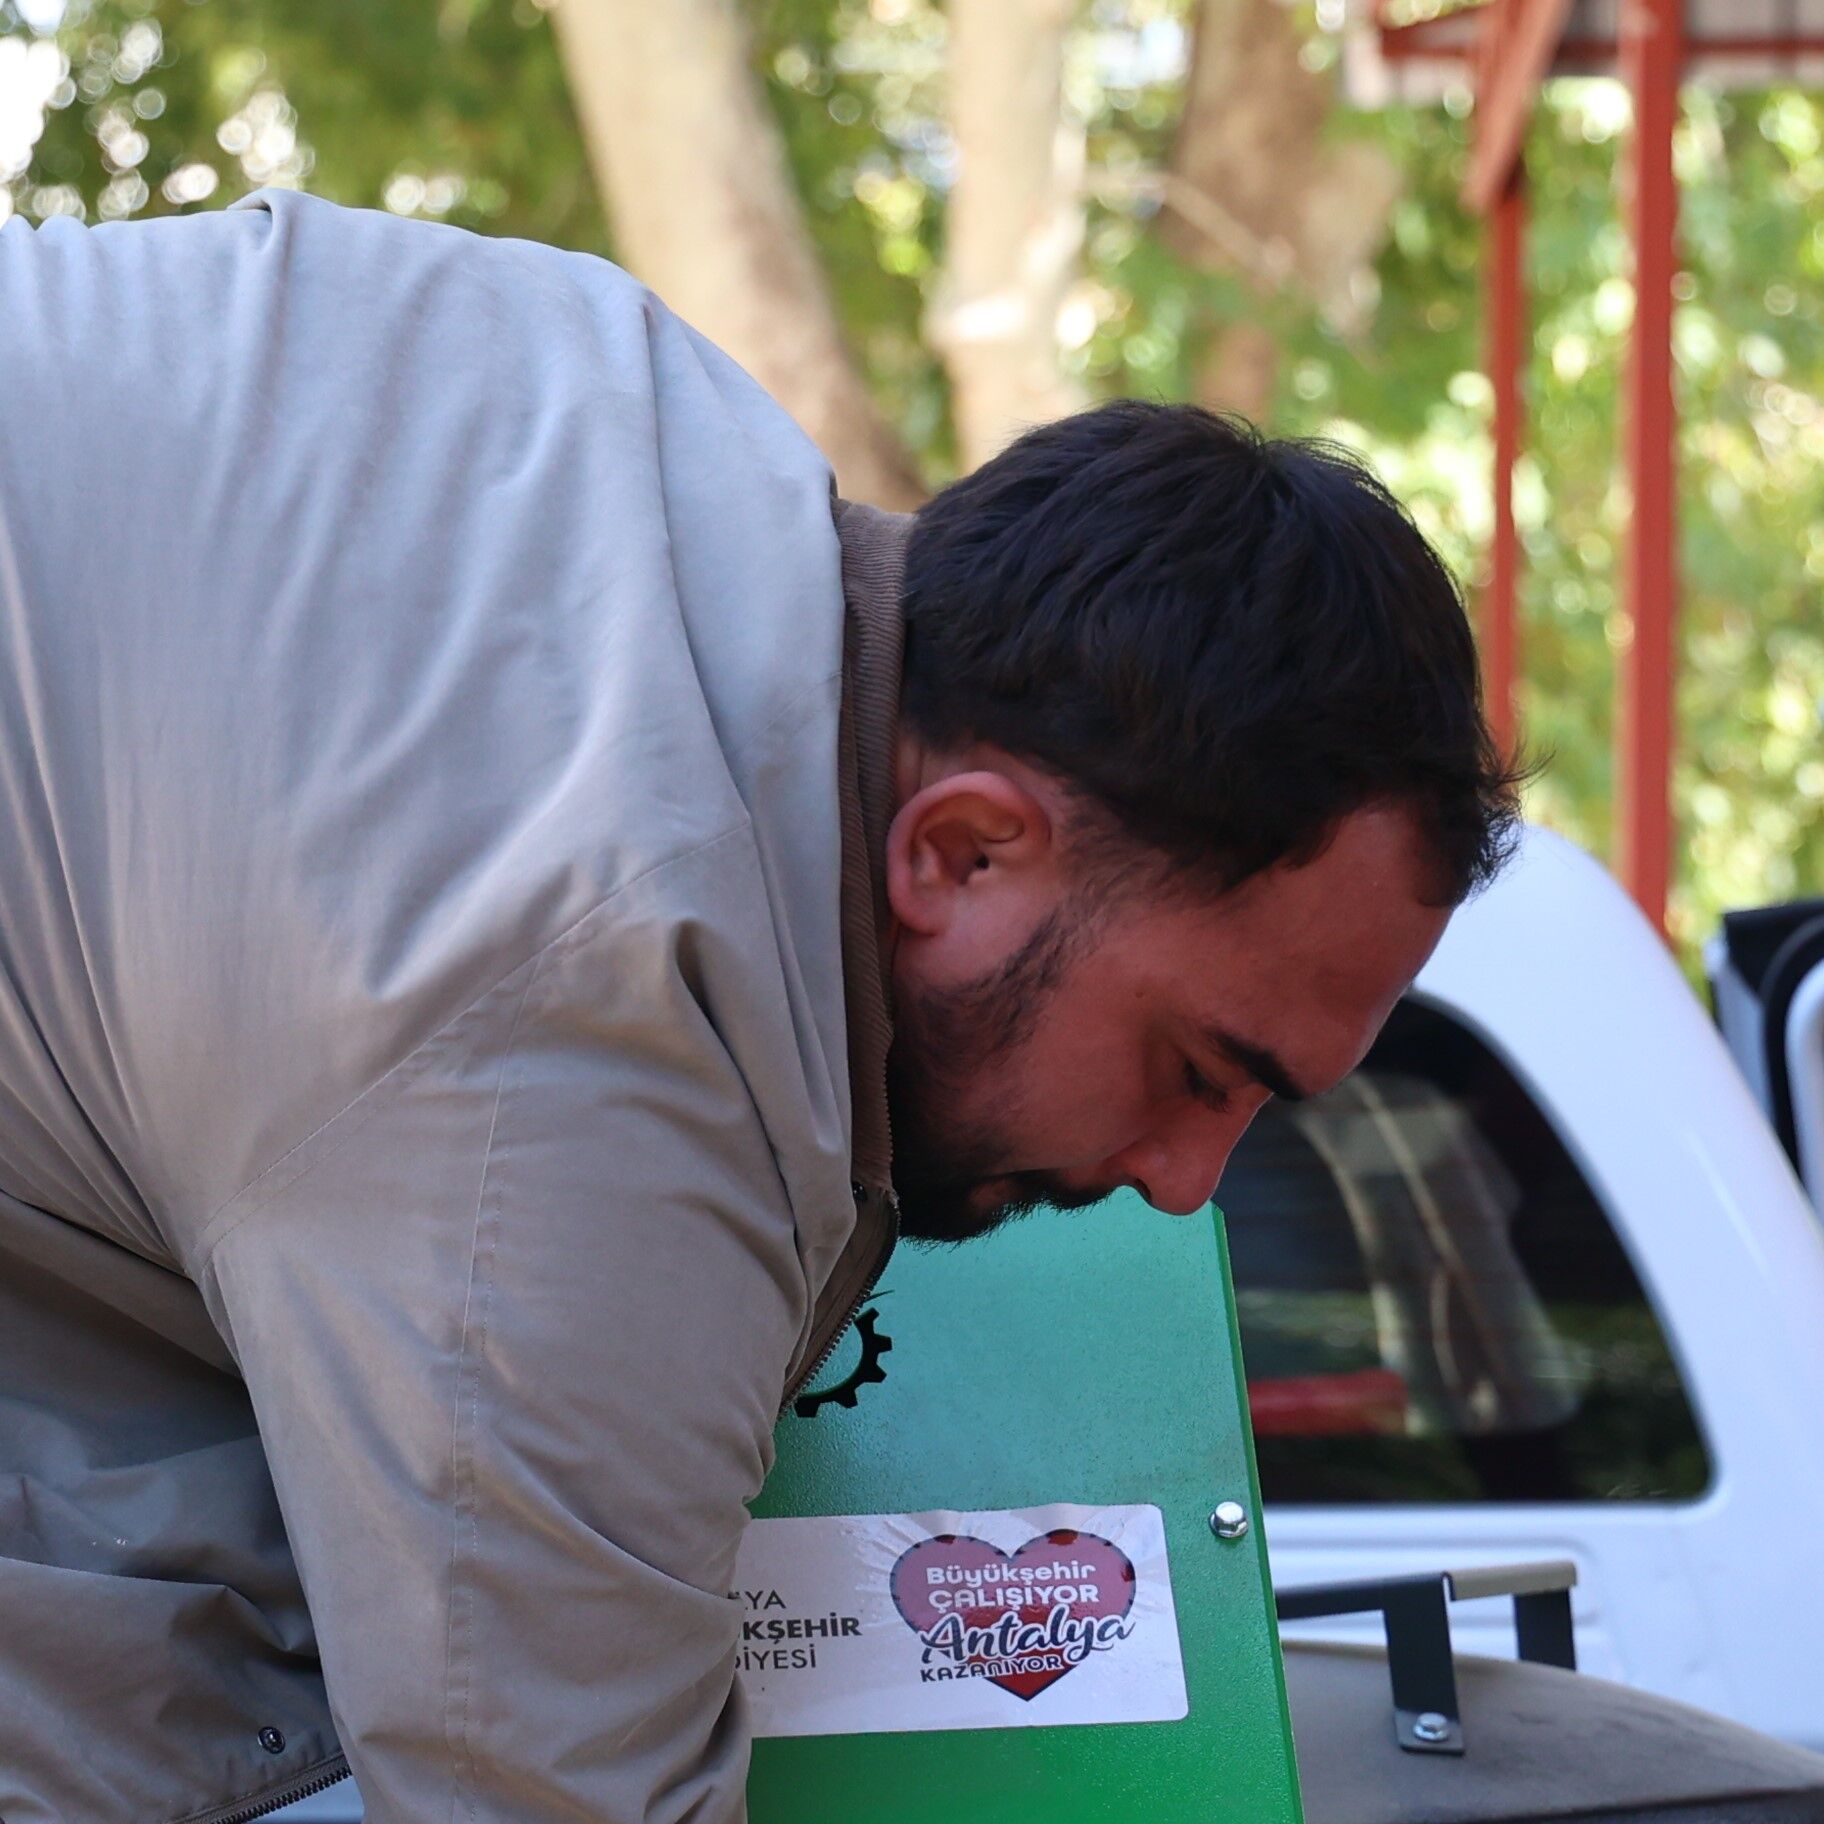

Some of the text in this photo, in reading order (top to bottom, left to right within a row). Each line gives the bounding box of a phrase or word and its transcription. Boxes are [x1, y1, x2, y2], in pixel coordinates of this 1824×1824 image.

[926, 1560, 1097, 1589] Büyükşehir
[741, 1589, 787, 1610] YA
[928, 1584, 1100, 1614] ÇALIŞIYOR
[742, 1611, 863, 1645] KŞEHİR
[920, 1605, 1137, 1664] Antalya
[735, 1643, 817, 1671] İYESİ
[919, 1655, 1063, 1683] KAZANIYOR
